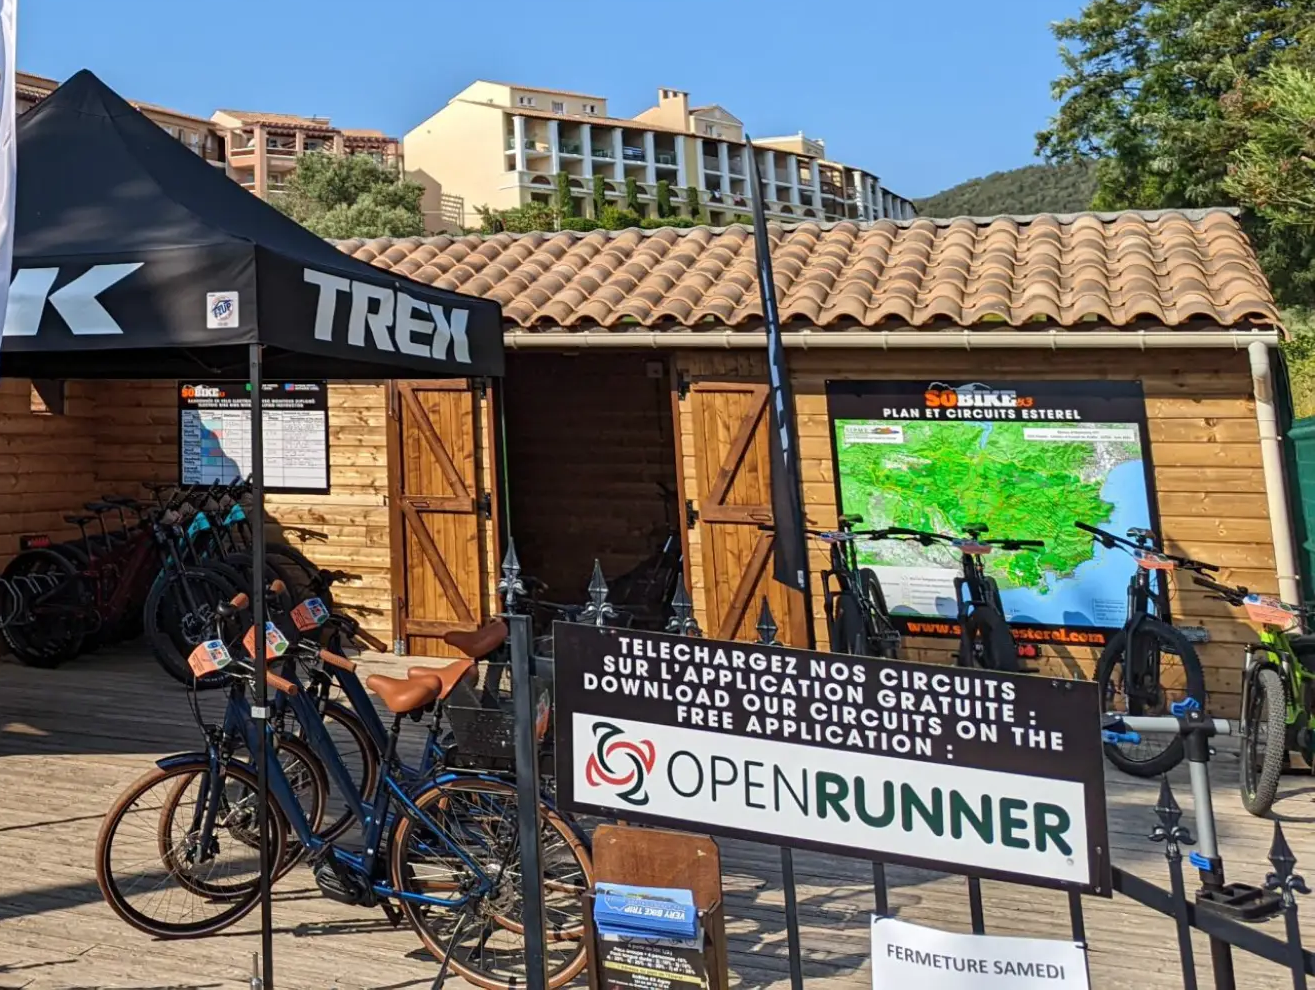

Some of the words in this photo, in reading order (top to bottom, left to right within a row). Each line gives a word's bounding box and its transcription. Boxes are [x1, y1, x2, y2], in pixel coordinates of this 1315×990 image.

[303, 267, 473, 364] TREK
[883, 408, 921, 419] PLAN
[925, 409, 941, 419] ET
[946, 409, 1016, 420] CIRCUITS
[1022, 409, 1081, 420] ESTEREL
[603, 655, 649, 677] SUR
[661, 662, 864, 705] L'APPLICATION
[877, 689, 1015, 722] GRATUITE
[1029, 711, 1037, 725] :
[619, 637, 798, 675] TELECHARGEZ
[810, 660, 866, 683] NOS
[879, 668, 1016, 700] CIRCUITS
[584, 672, 730, 708] DOWNLOAD
[742, 693, 797, 717] OUR
[810, 702, 942, 735] CIRCUITS
[956, 720, 998, 743] ON
[1011, 726, 1064, 751] THE
[677, 705, 733, 729] FREE
[746, 715, 932, 757] APPLICATION
[946, 744, 953, 759] :
[666, 750, 1073, 857] OPENRUNNER
[887, 943, 989, 974] FERMETURE
[993, 960, 1066, 980] SAMEDI
